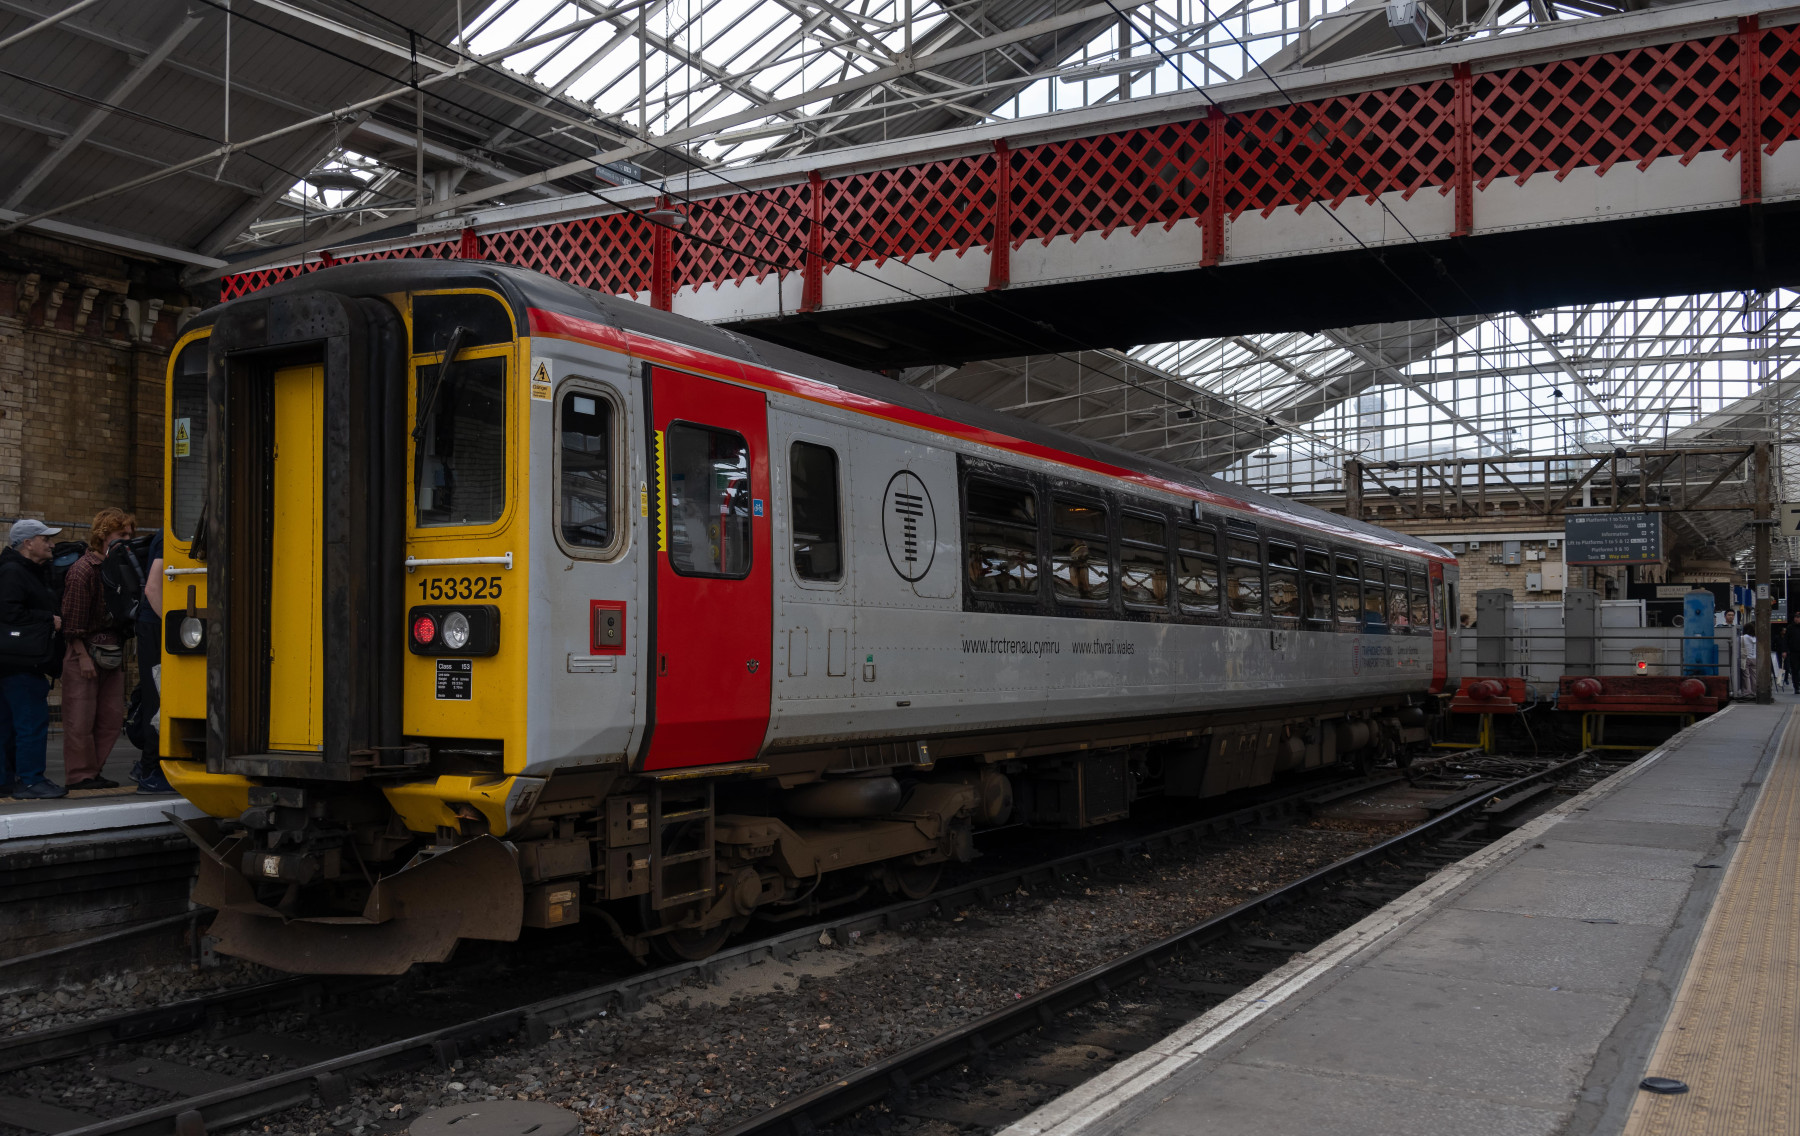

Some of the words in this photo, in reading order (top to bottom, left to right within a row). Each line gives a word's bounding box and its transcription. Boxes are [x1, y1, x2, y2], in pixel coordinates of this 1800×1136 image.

[419, 576, 502, 600] 153325
[962, 638, 1060, 658] www.trctrenau.cymru
[1072, 638, 1134, 655] www.tfwrail.wales
